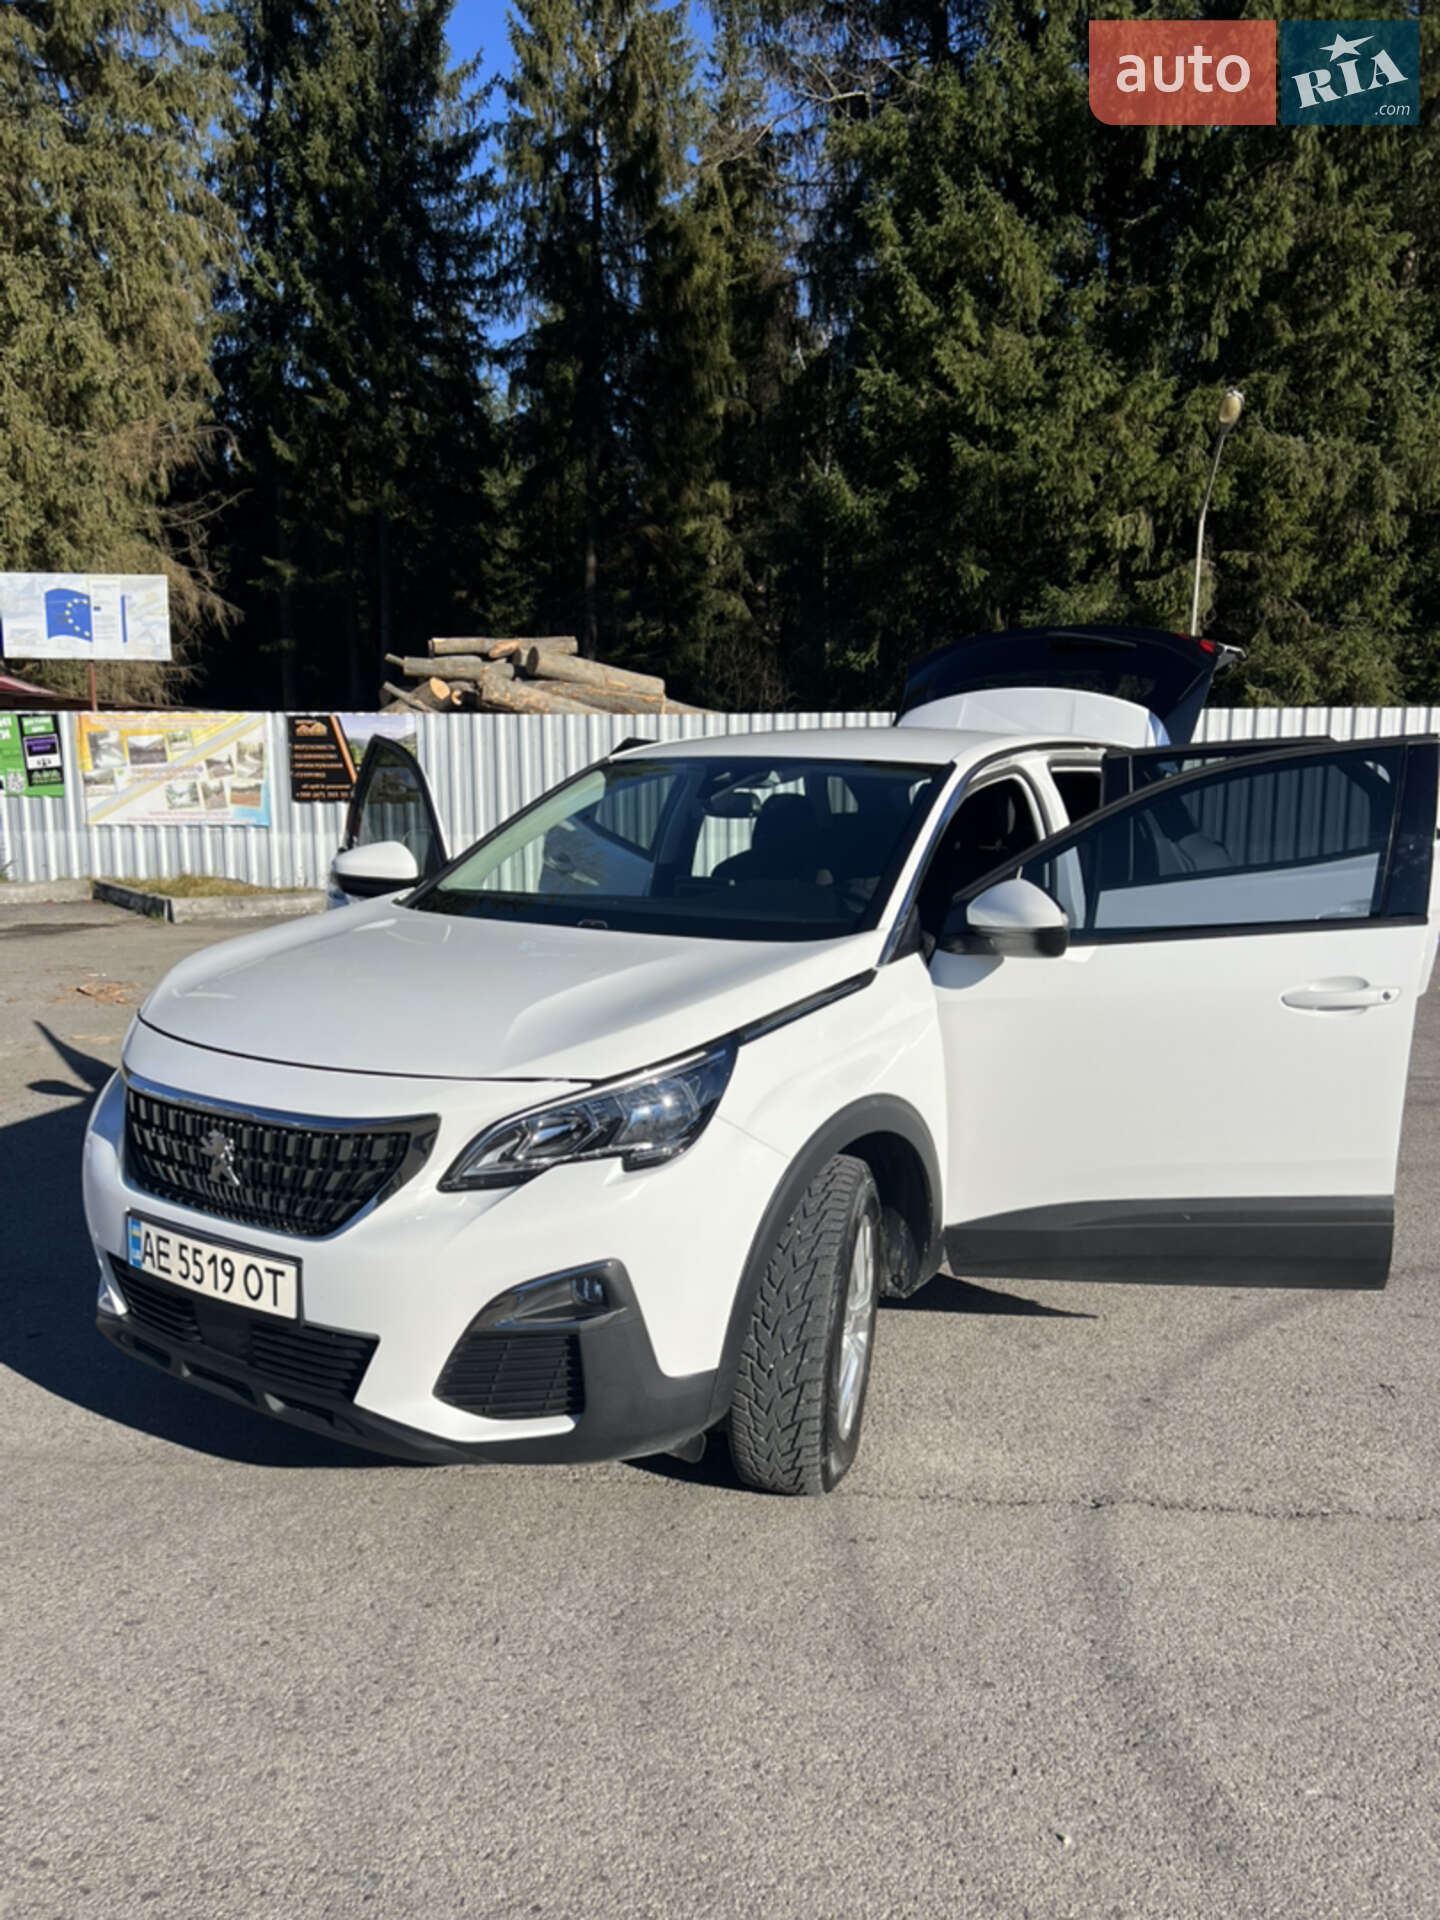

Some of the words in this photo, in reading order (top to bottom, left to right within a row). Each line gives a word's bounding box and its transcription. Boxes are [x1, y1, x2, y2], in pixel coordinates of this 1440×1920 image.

[143, 1231, 173, 1276] AE
[178, 1243, 235, 1294] 5519
[244, 1263, 286, 1307] OT
